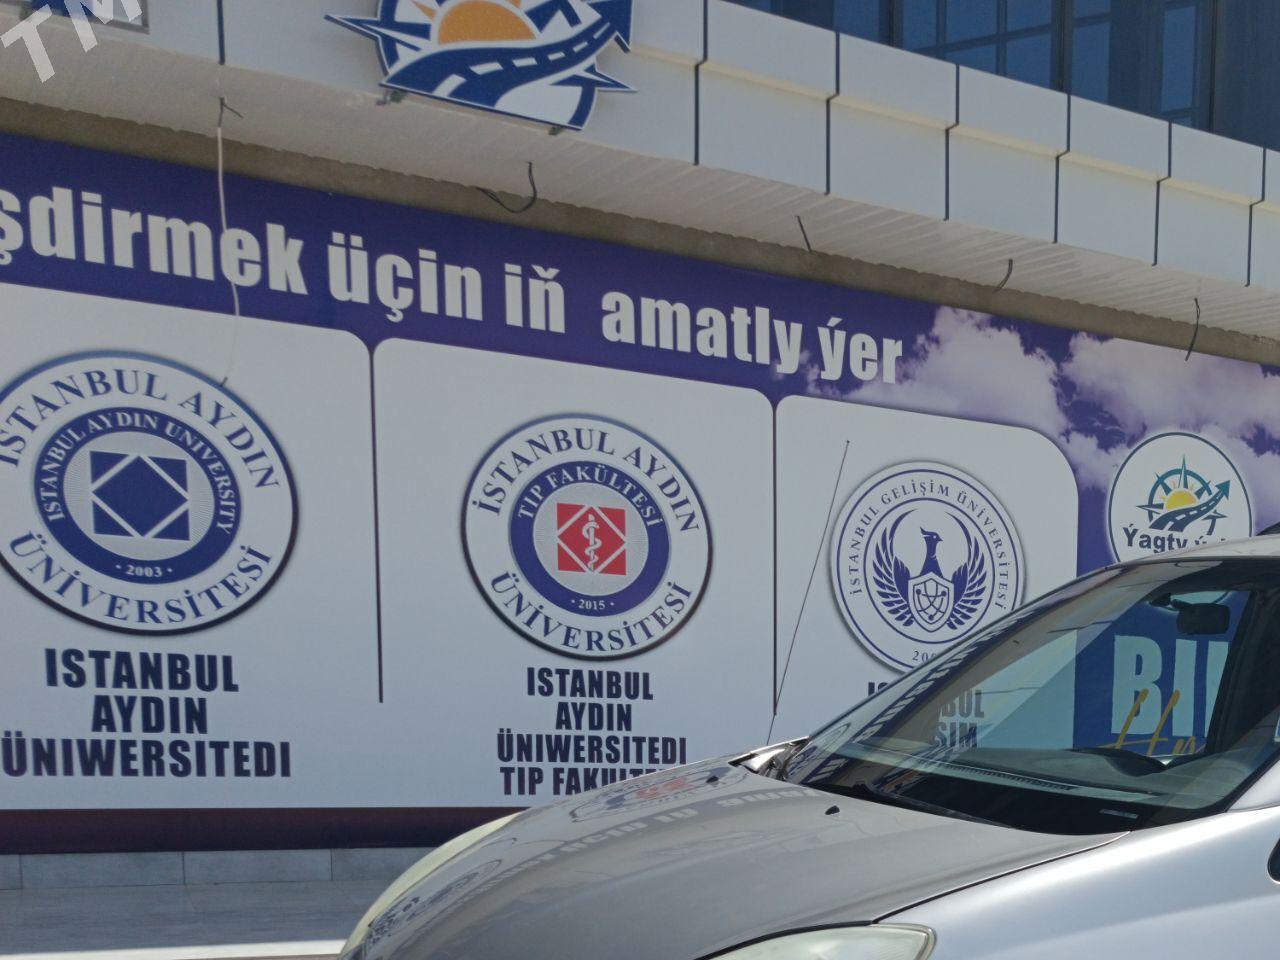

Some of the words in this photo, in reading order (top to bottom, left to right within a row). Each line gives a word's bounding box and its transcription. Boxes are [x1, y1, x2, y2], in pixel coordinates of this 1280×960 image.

[0, 186, 308, 297] şdirmek
[328, 232, 483, 323] üçin
[503, 264, 566, 334] iň
[601, 290, 803, 375] amatly
[817, 317, 903, 384] ýer
[179, 391, 280, 490] AYDIN
[40, 428, 86, 522] ISTANBUL
[87, 412, 159, 434] AYDIN
[165, 422, 237, 534] UNIVERSITY
[471, 427, 616, 517] İSTANBUL
[623, 446, 700, 533] AYDIN
[518, 484, 546, 519] TIP
[546, 464, 664, 527] FAKÜLTESİ
[849, 506, 879, 596] İSTANBUL
[881, 479, 951, 504] GELİŞİM
[957, 490, 1009, 611] ÜNİVERSİTESİ
[10, 531, 273, 624] ÜNİVERSİTESİ
[125, 564, 163, 578] 2003
[490, 570, 692, 652] ÜNİVERSİTESİ
[578, 599, 606, 610] 2015
[45, 648, 239, 692] ISTANBUL
[527, 667, 654, 700] ISTANBUL
[91, 695, 208, 734] AYDIN
[555, 702, 633, 731] AYDIN
[1, 730, 291, 778] ÜNIWERSITEDI
[497, 728, 687, 764] ÜNIWERSITEDI
[500, 766, 544, 795] TIP
